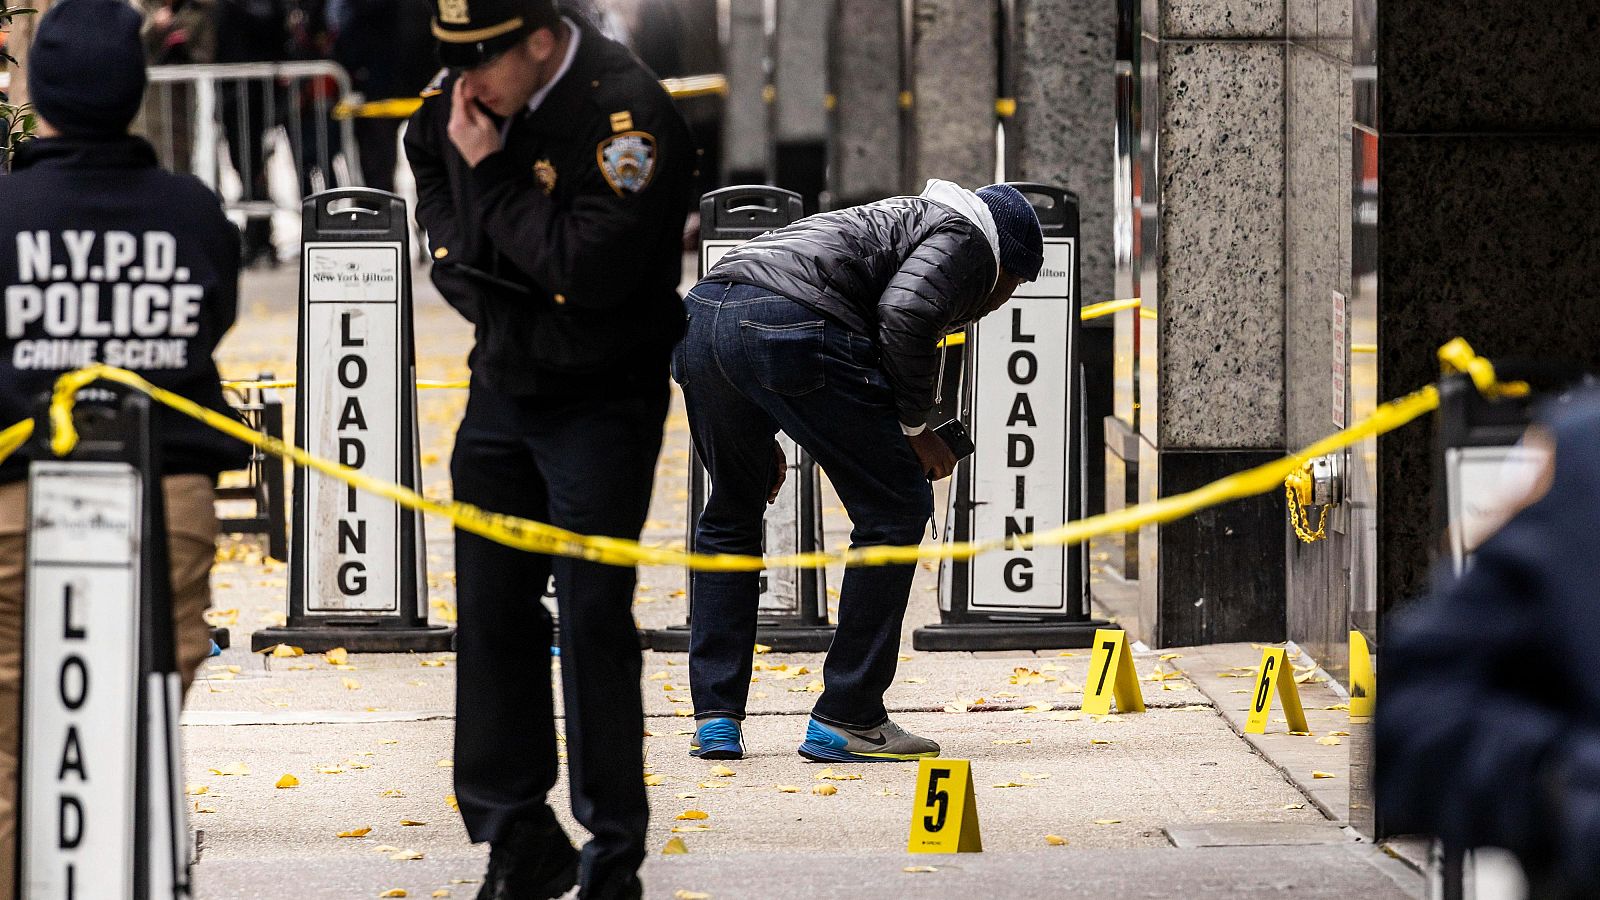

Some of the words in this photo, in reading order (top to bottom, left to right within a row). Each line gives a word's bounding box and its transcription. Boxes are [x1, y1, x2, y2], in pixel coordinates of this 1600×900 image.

[16, 230, 191, 282] N.Y.P.D.
[313, 273, 335, 282] New
[337, 272, 360, 282] York
[362, 272, 394, 282] Hilton
[1039, 268, 1066, 278] ilton
[5, 282, 204, 339] POLICE
[13, 340, 98, 370] CRIME
[104, 340, 188, 369] SCENE
[337, 313, 368, 596] LOADING
[1003, 308, 1038, 592] LOADING
[1095, 641, 1116, 696] 7
[1255, 656, 1275, 713] 6
[923, 768, 951, 833] 5
